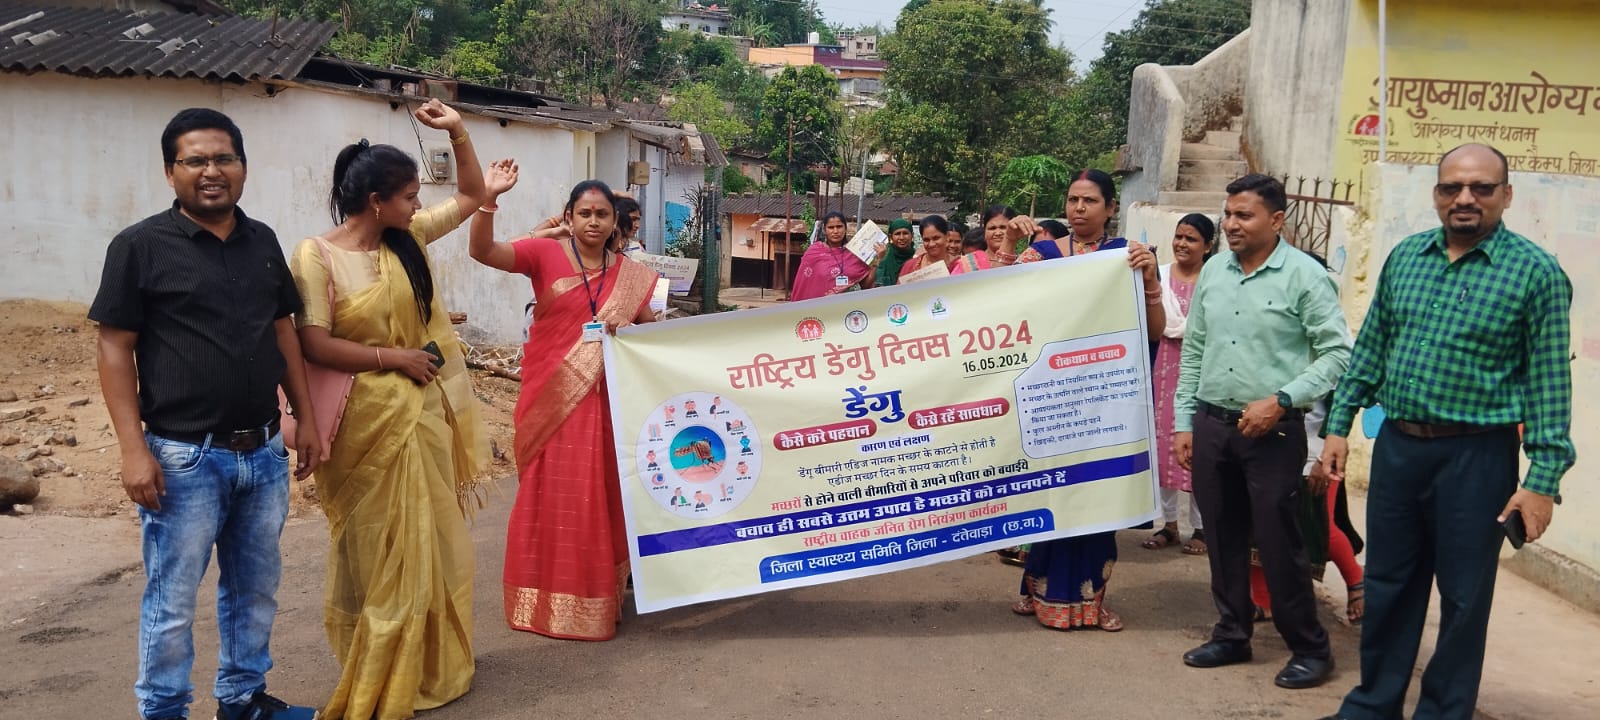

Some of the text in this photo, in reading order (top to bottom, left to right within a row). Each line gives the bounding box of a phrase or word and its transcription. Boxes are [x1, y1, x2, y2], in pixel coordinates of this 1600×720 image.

[1369, 76, 1490, 119] आयुष्मान
[1488, 70, 1594, 116] आरोग्य
[726, 319, 1033, 389] राष्ट्रिय डेंगु दिवस 2024
[962, 352, 1028, 373] 16.05.2024
[1055, 348, 1120, 367] रोकथाम व बचाव
[841, 385, 906, 423] डेंगु
[915, 403, 1003, 428] कैसे रहें सावधान
[780, 424, 870, 449] कैसे करे पहचान
[814, 461, 842, 475] बीमारी
[870, 454, 896, 467] नामक
[896, 450, 921, 463] मच्छर
[922, 447, 933, 458] के
[934, 442, 958, 457] काटने
[959, 442, 969, 453] से
[970, 438, 988, 451] होती
[988, 436, 997, 449] है
[861, 434, 931, 453] कारण एवं लक्षण
[770, 458, 1029, 512] मच्छरों से होने वाली बीमारियों से अपने परिवार को बचाईये
[854, 471, 878, 483] मच्छर
[879, 466, 896, 478] दिन
[897, 464, 907, 475] के
[908, 461, 931, 473] समय
[932, 457, 960, 469] काटता
[960, 453, 973, 466] है।
[735, 470, 1067, 538] बचाव ही सबसे उत्तम उपाय है मच्छरों को न पनपने दें
[840, 527, 870, 541] वाहक
[872, 520, 905, 535] जनित
[908, 514, 926, 530] रोग
[928, 510, 966, 527] नियंत्रण
[969, 502, 1008, 519] कार्यक्रम
[770, 560, 804, 575] जिला
[807, 551, 856, 569] स्वास्थ्य
[860, 540, 902, 560] समिति
[906, 536, 938, 552] जिला
[952, 525, 993, 543] दंतेवाड़ा
[1002, 516, 1045, 535] (छ.ग.)
